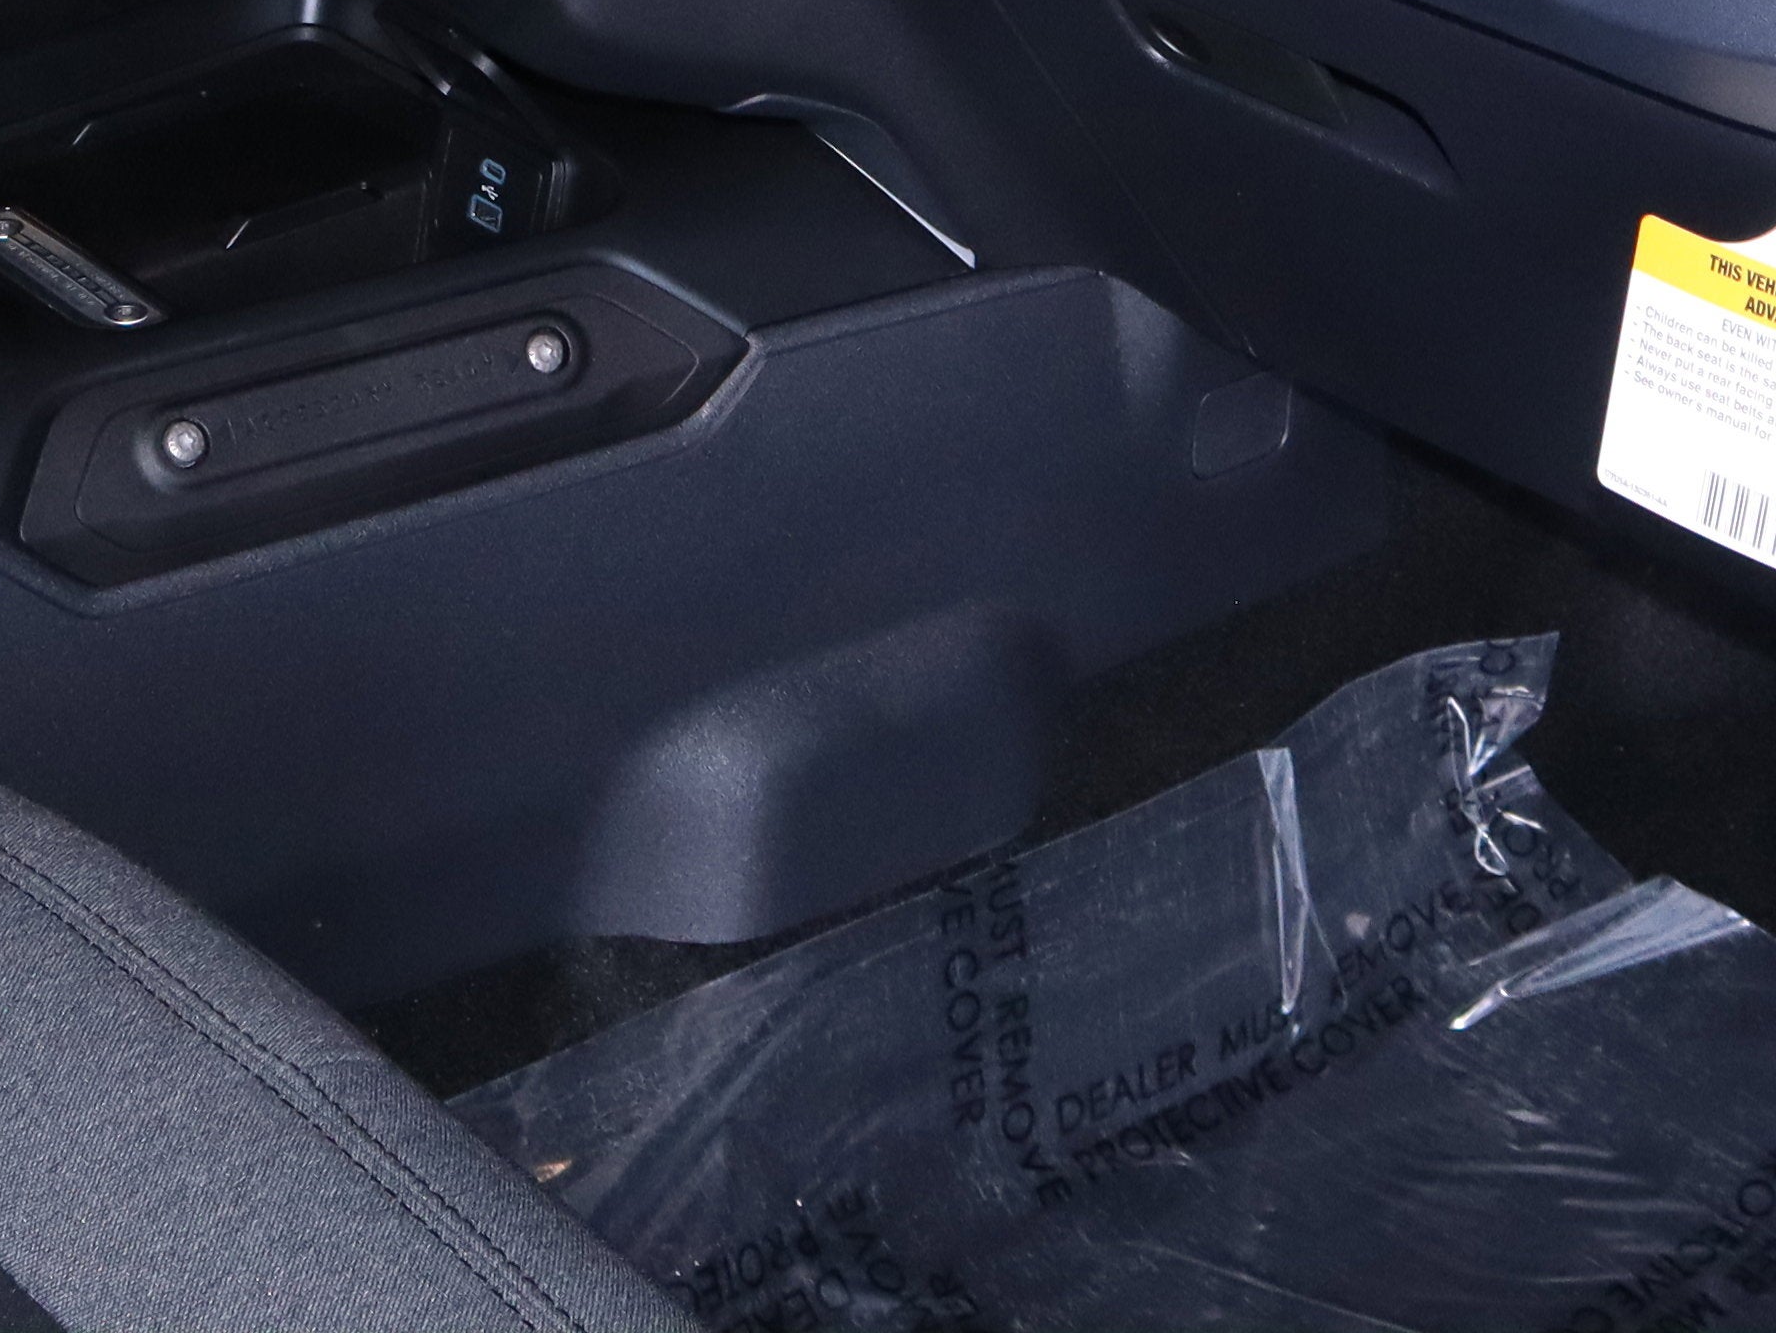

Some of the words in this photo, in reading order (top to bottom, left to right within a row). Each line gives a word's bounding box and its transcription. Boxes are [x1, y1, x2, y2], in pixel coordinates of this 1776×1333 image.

[1707, 253, 1744, 283] THIS
[1640, 321, 1664, 343] The
[1665, 331, 1695, 356] back
[1696, 346, 1723, 369] seat
[1724, 358, 1737, 375] is
[1738, 364, 1760, 384] the
[1643, 304, 1694, 337] Children
[1696, 329, 1719, 349] can
[1720, 337, 1738, 357] be
[1739, 345, 1773, 371] killed
[1720, 317, 1752, 343] EVEN
[1632, 369, 1656, 391] See
[1656, 382, 1704, 412] owner's
[1705, 403, 1752, 434] manual
[1753, 422, 1773, 443] for
[1634, 353, 1678, 386] Always
[1679, 376, 1702, 395] use
[1704, 385, 1731, 407] seat
[1732, 396, 1765, 422] belts
[1638, 337, 1673, 364] Never
[1673, 354, 1695, 376] put
[1696, 365, 1705, 378] a
[1707, 369, 1732, 390] rear
[1733, 379, 1774, 409] facing
[938, 946, 992, 1130] COVER
[994, 994, 1073, 1208] REMOVE
[1054, 1041, 1198, 1135] DEALER
[1074, 1057, 1292, 1182] PROTECTIVE
[1292, 977, 1424, 1076] COVER
